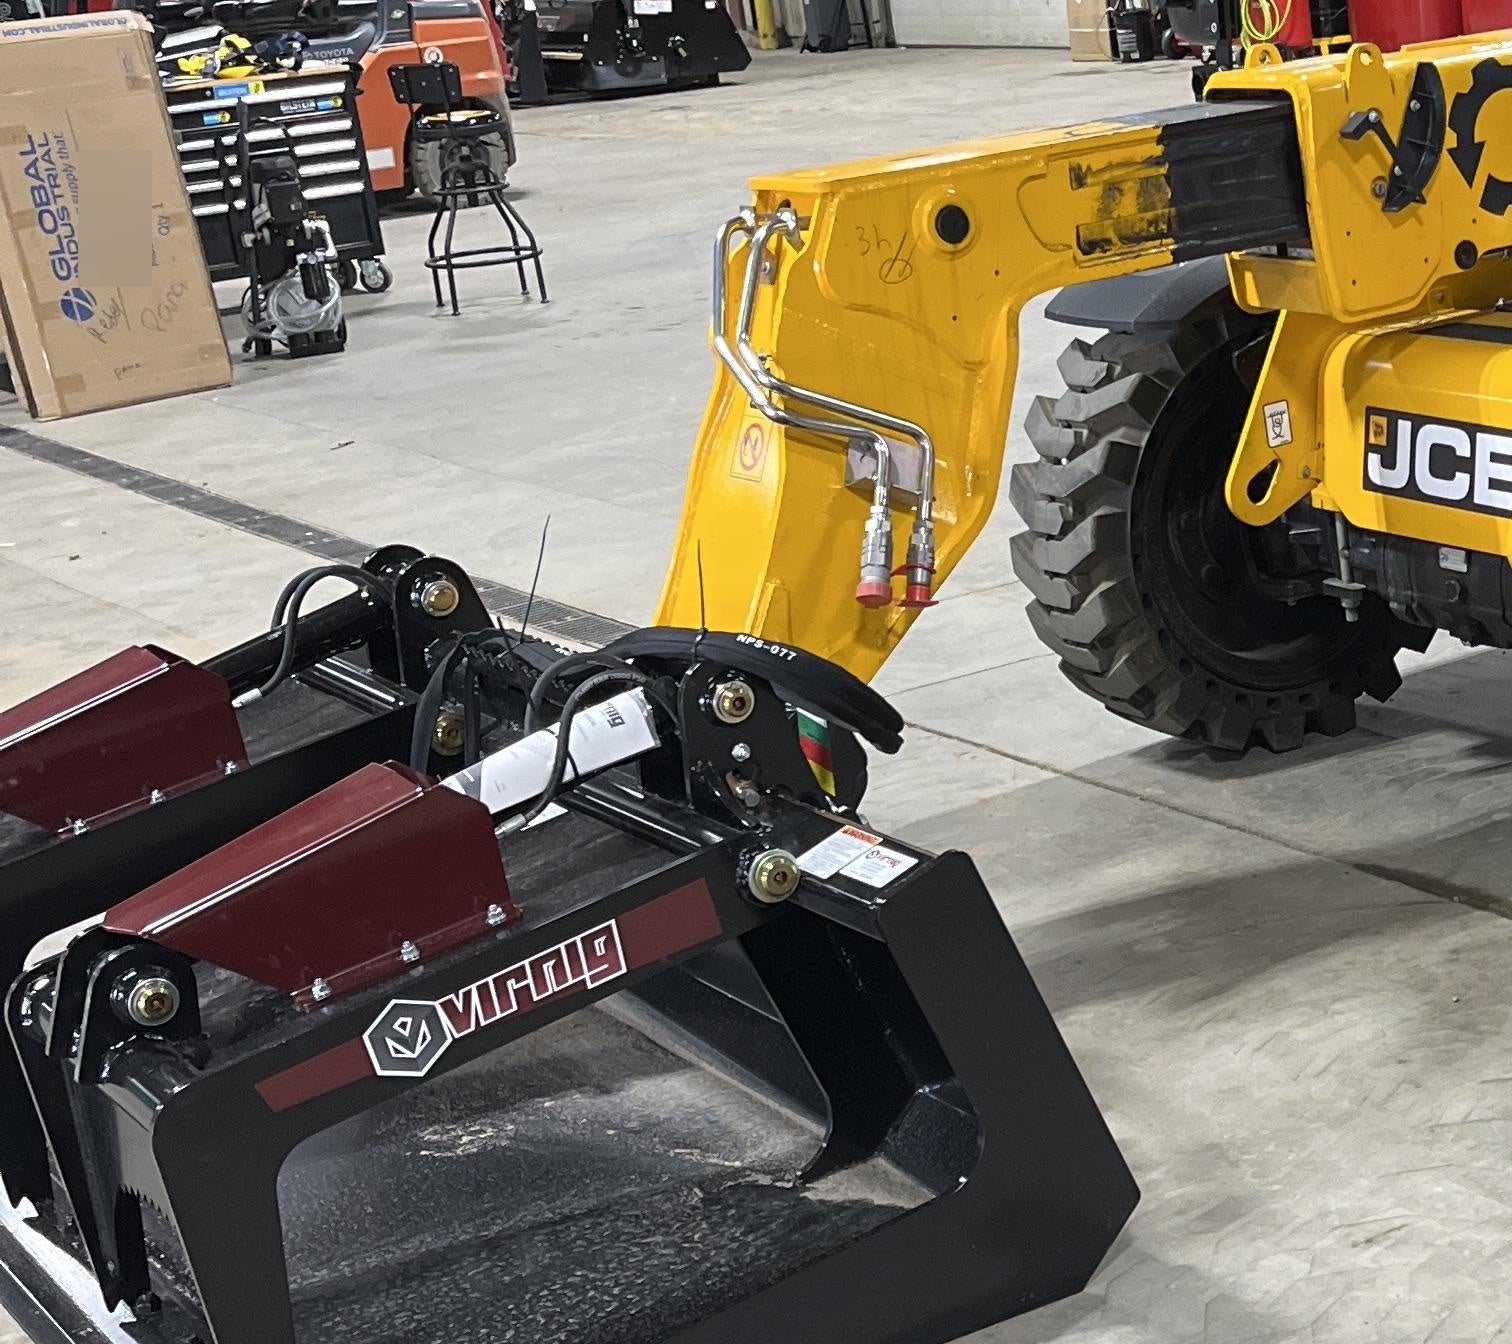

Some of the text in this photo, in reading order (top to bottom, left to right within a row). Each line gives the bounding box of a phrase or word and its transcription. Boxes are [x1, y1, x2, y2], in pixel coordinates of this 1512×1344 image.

[313, 47, 354, 59] TOYOTA
[19, 134, 73, 281] GLOBAL
[157, 214, 170, 236] Qty
[736, 634, 798, 661] NPS-077
